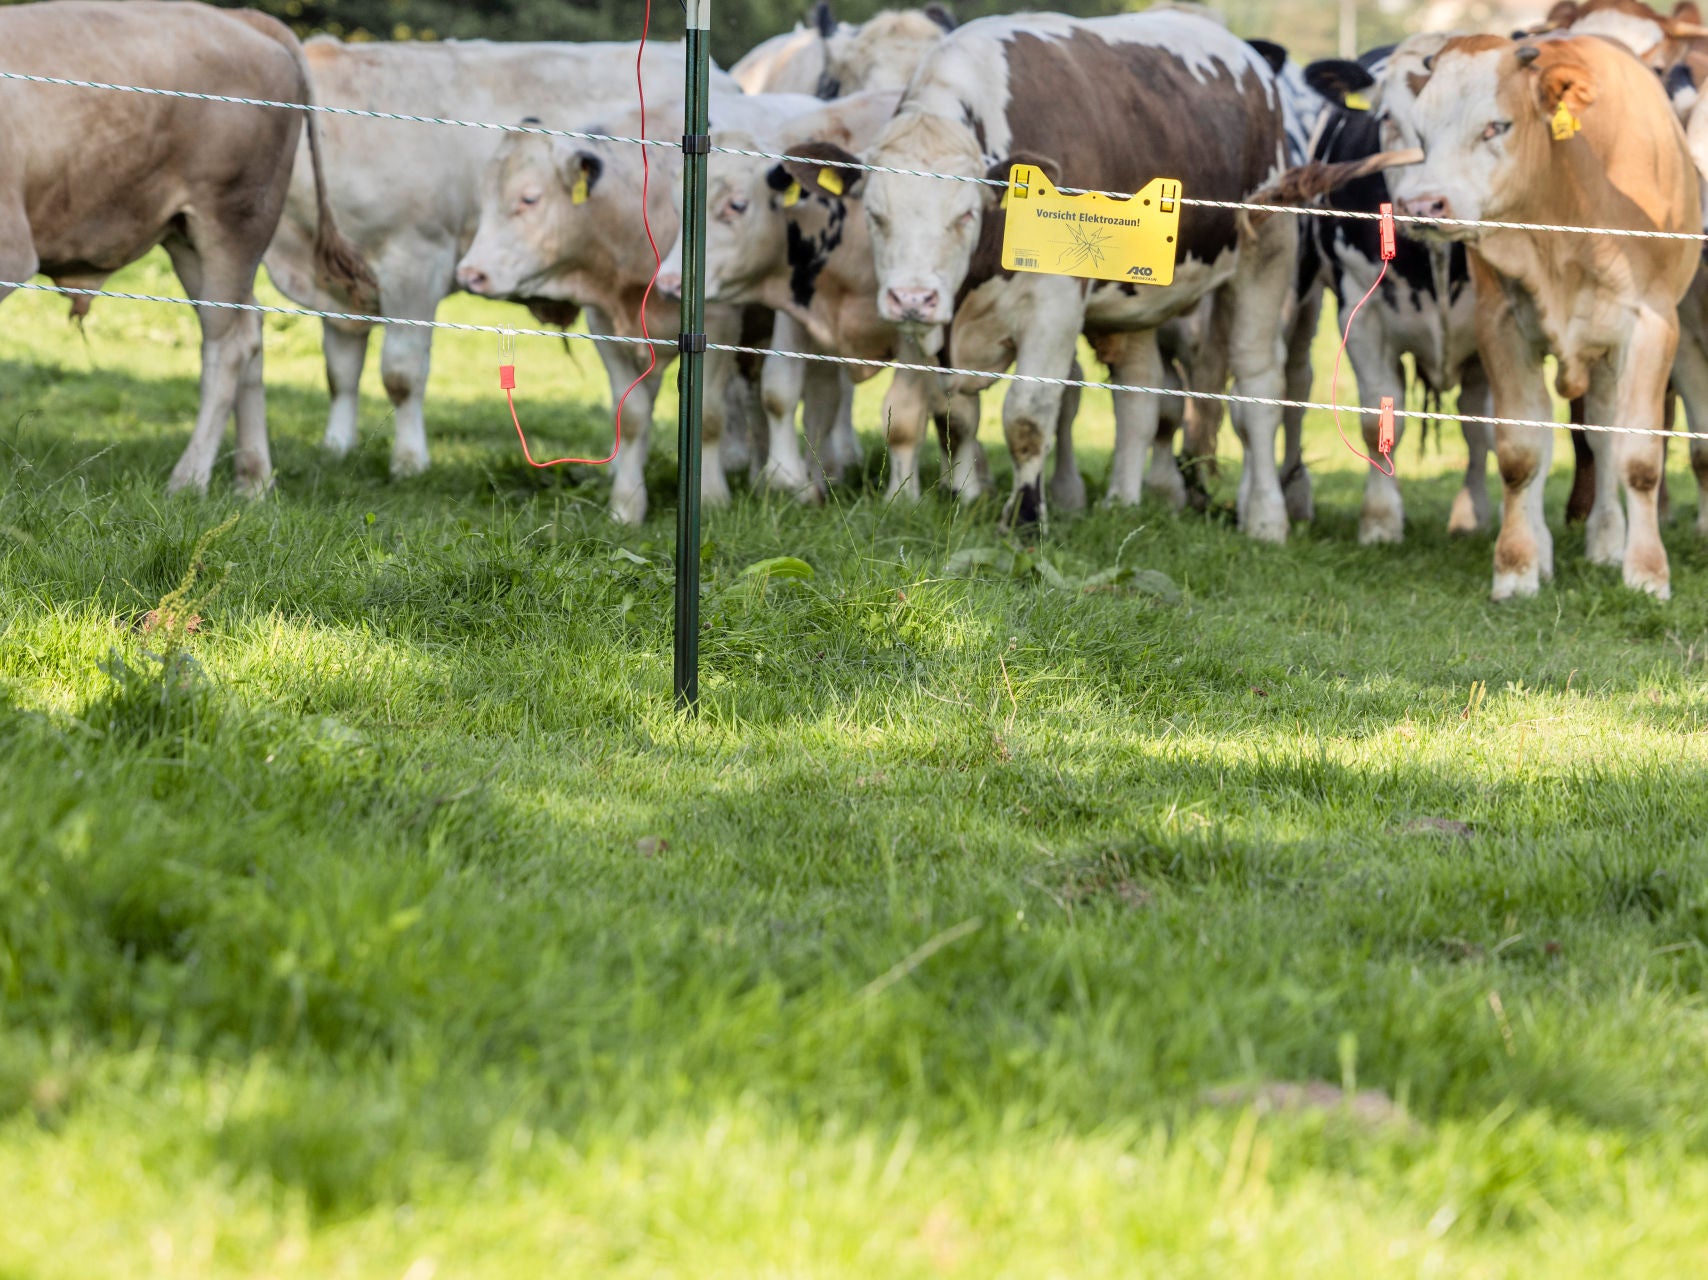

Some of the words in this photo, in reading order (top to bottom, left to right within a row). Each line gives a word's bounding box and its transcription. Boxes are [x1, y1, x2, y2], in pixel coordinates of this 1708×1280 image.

[1036, 208, 1076, 221] Vorsicht
[1079, 212, 1140, 227] Elektrozaun!
[1126, 266, 1153, 276] AKO
